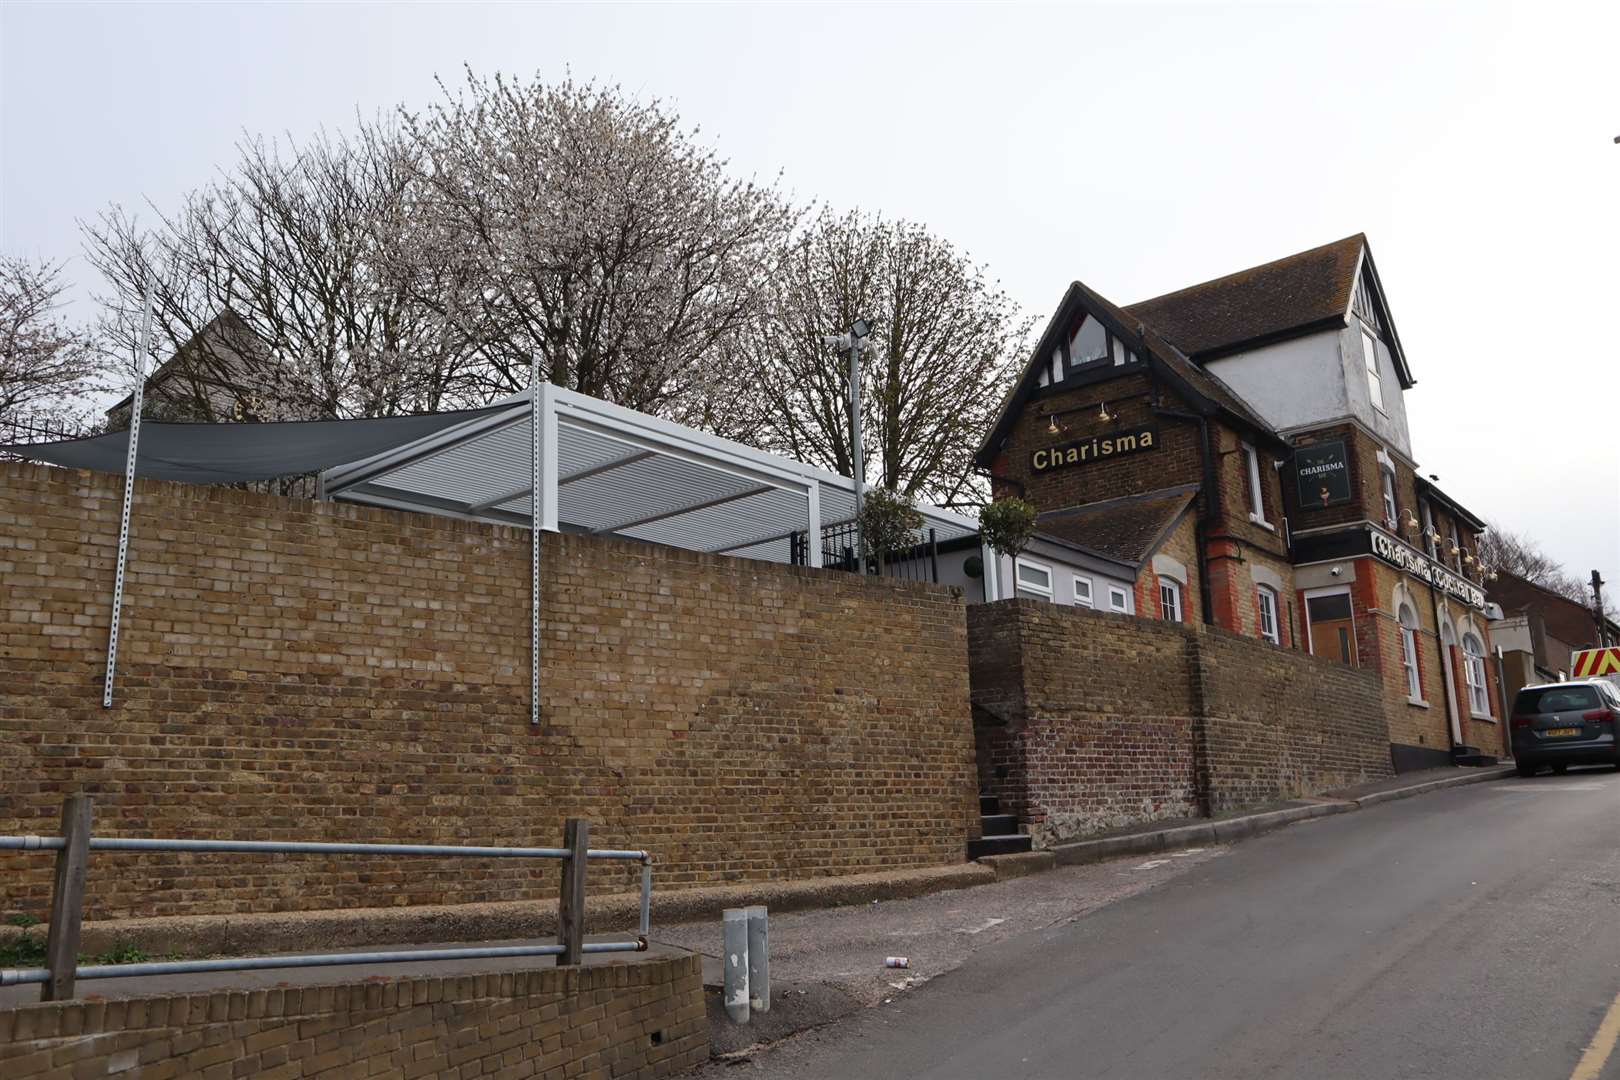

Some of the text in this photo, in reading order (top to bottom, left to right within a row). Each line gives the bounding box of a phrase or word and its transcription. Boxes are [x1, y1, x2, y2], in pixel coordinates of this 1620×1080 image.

[1033, 431, 1153, 469] Charisma
[1300, 461, 1344, 476] CHARISMA
[1376, 535, 1432, 582] Charisma
